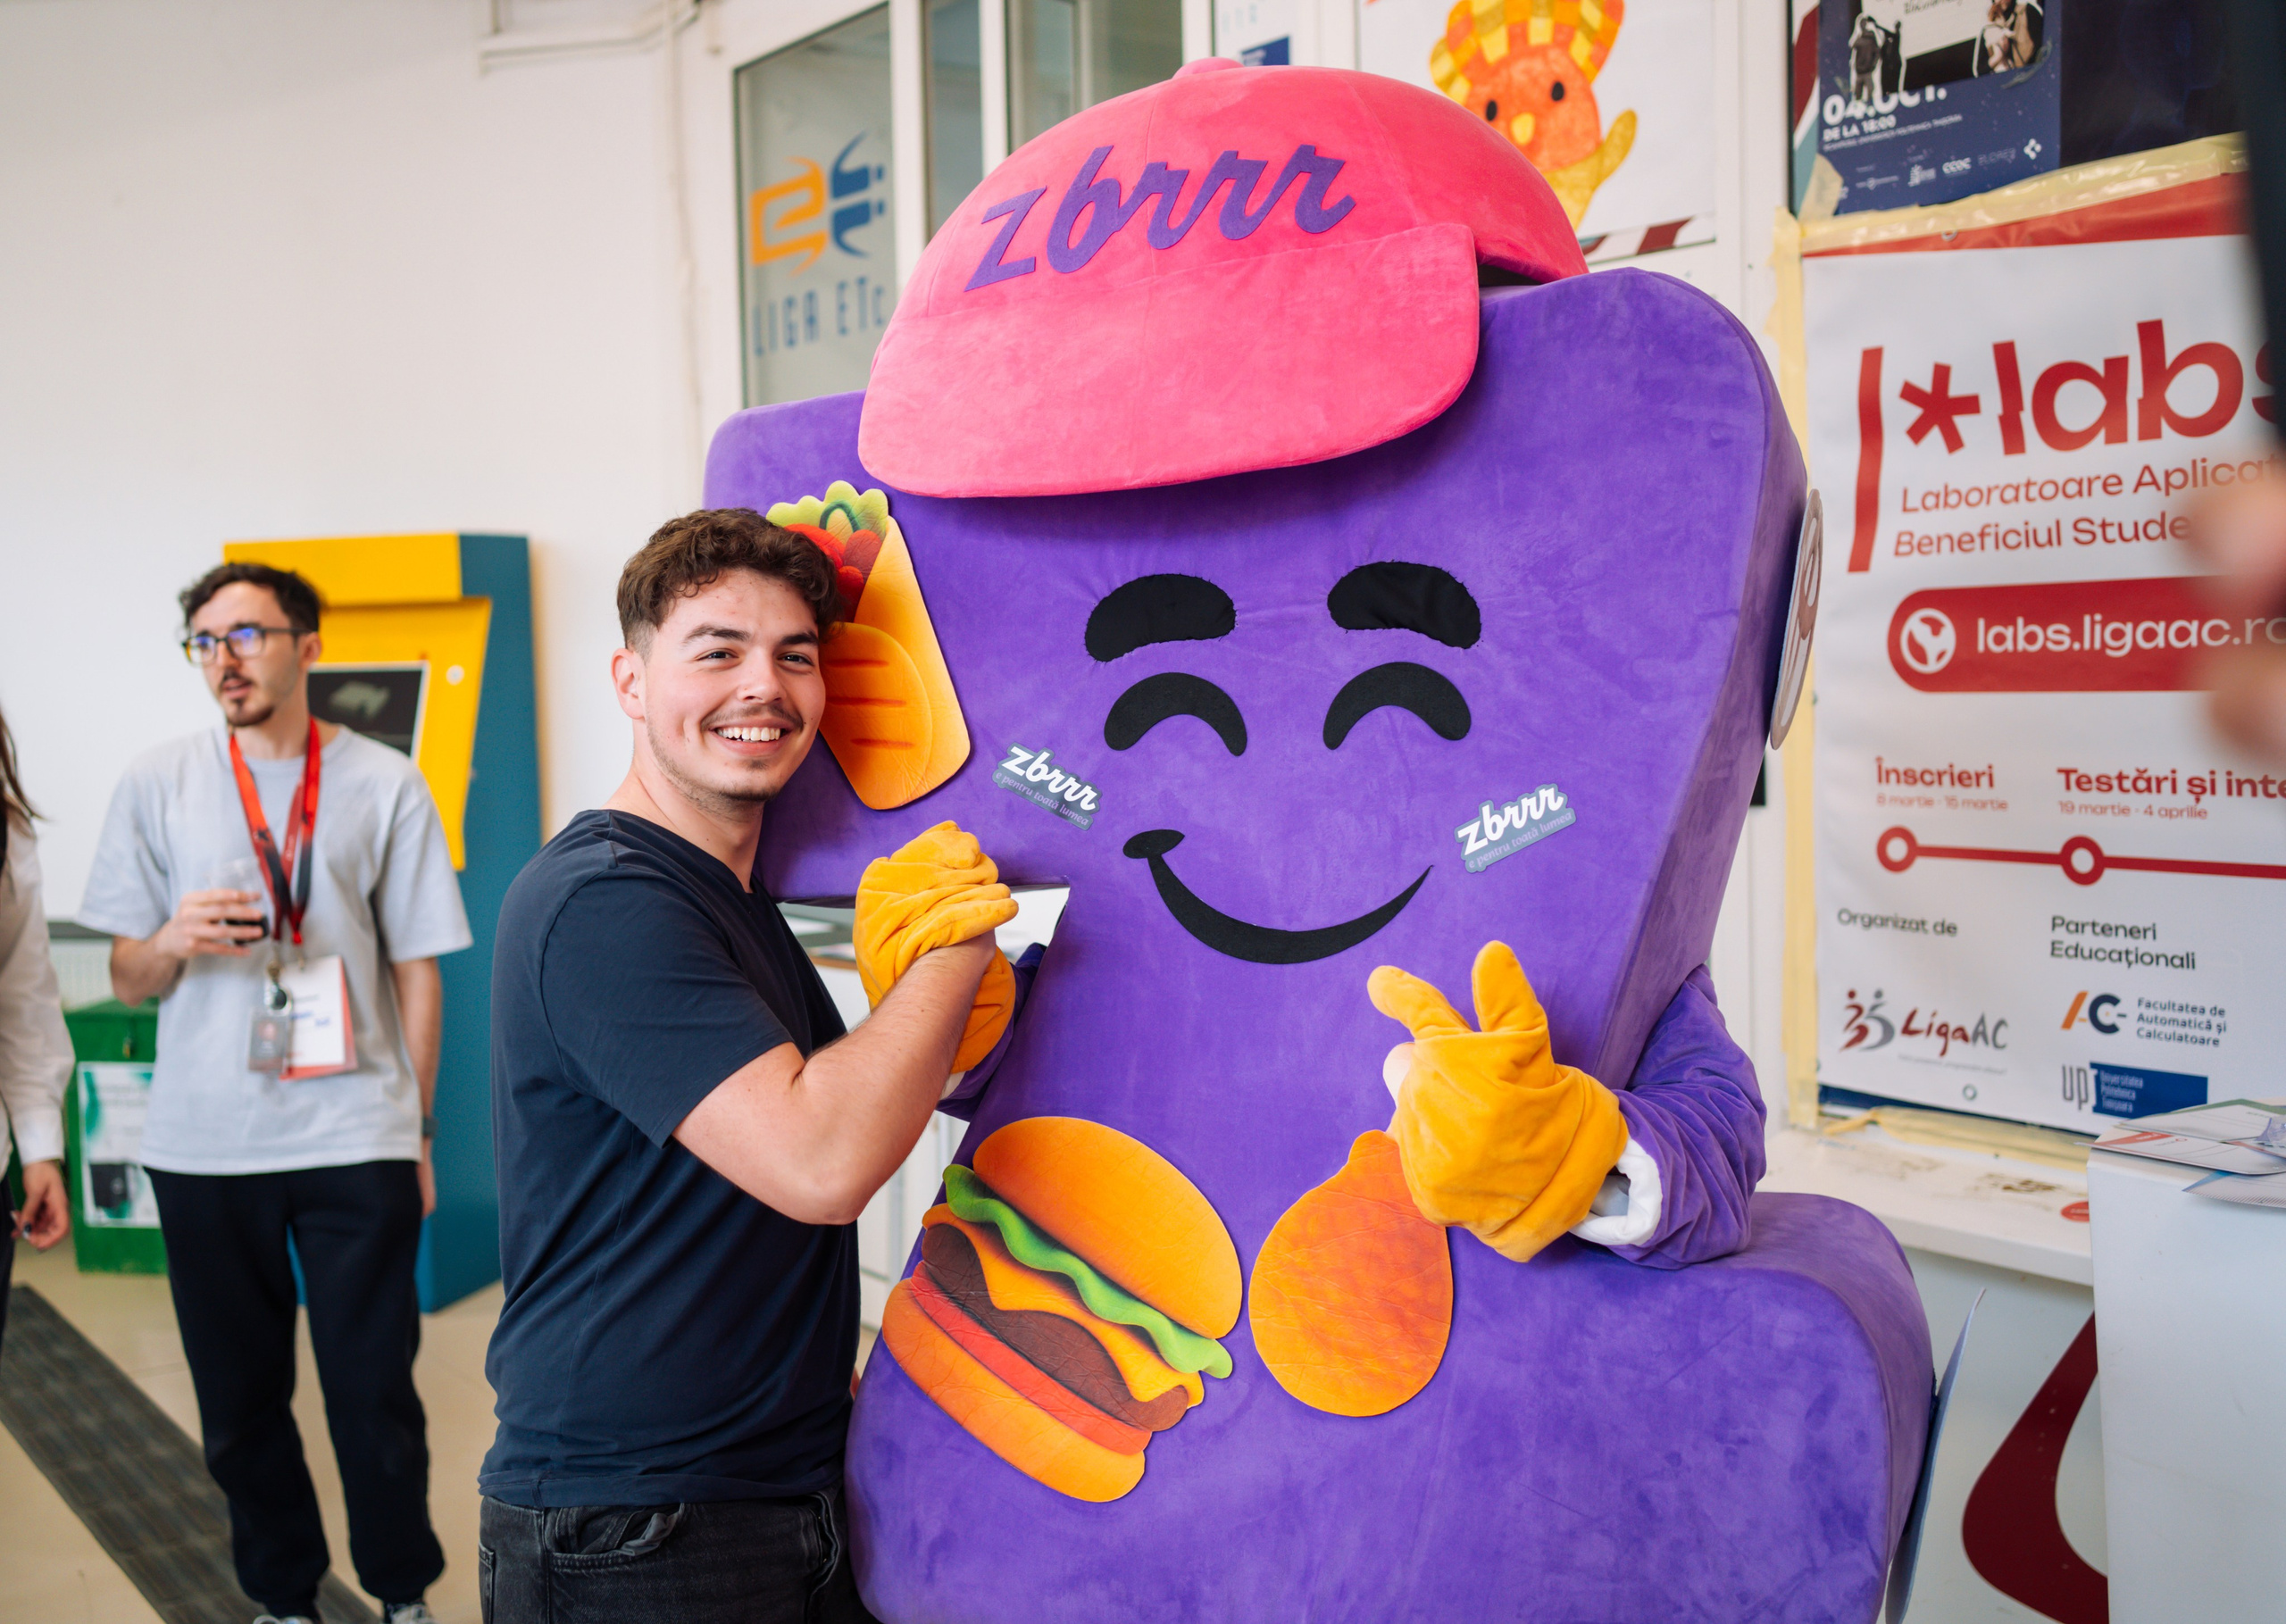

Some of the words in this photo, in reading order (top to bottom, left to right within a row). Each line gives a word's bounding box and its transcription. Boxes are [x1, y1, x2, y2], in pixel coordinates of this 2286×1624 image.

[1823, 126, 1841, 142] DE
[1842, 123, 1861, 138] LA
[964, 144, 1356, 292] zbrrr
[753, 290, 820, 355] LIGA
[1901, 472, 2123, 513] Laboratoare
[1893, 520, 2062, 557] Beneficiul
[2071, 512, 2192, 545] Stude
[1001, 745, 1097, 811] zbrrr
[2057, 768, 2177, 795] Testări
[2187, 770, 2217, 804] și
[1001, 775, 1033, 796] pentru
[1034, 792, 1059, 811] toată
[1059, 804, 1089, 826] lumea
[1961, 796, 2008, 812] martie
[2058, 800, 2075, 815] 19
[2079, 802, 2131, 817] martie
[2143, 804, 2154, 818] 4
[2157, 804, 2207, 820] aprilie
[1457, 787, 1564, 855] zbrrr
[1476, 842, 1511, 867] pentru
[1512, 829, 1539, 847] toată
[1539, 812, 1573, 834] lumea
[1838, 908, 1929, 935] Organizat
[1933, 918, 1958, 937] de
[2051, 914, 2157, 941] Parteneri
[2050, 939, 2196, 970] Educaționali
[2136, 1013, 2213, 1031] Automatică
[2137, 996, 2207, 1015] Facultatea
[2209, 1005, 2226, 1017] de
[2136, 1028, 2221, 1047] Calculatoare
